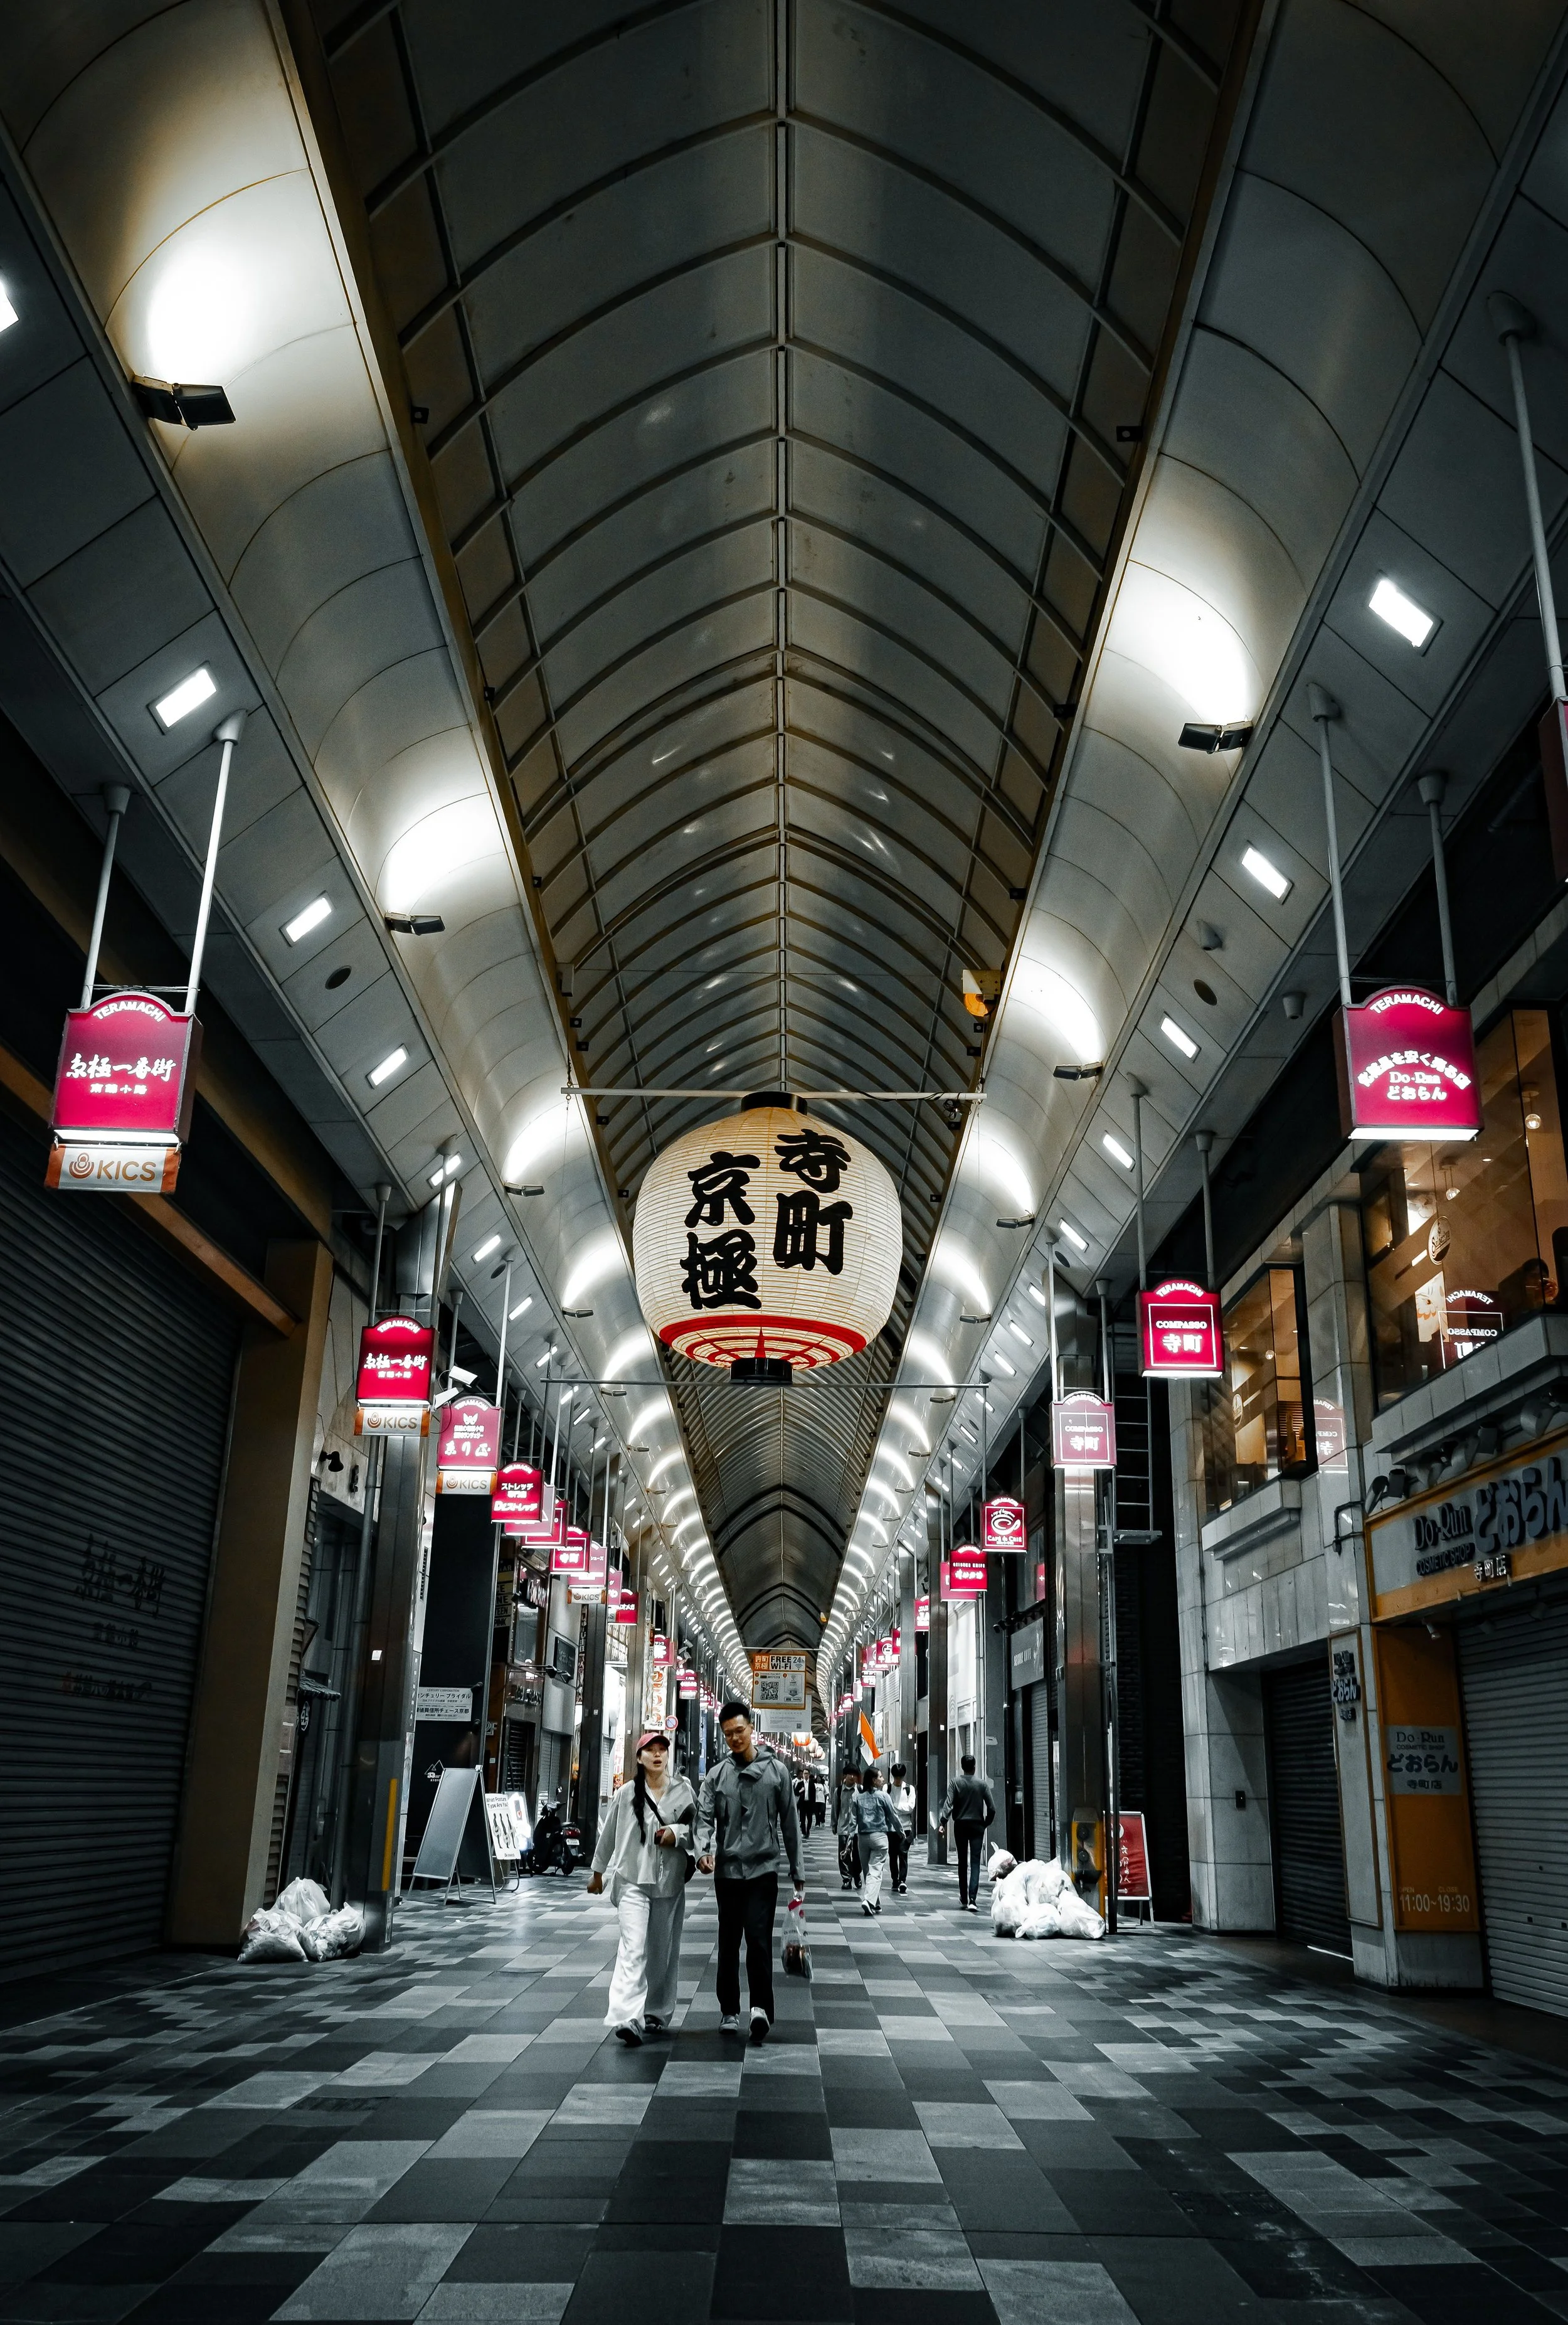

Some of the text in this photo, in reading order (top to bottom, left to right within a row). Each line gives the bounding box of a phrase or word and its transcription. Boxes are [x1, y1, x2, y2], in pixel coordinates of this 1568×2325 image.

[93, 1001, 167, 1023] TERAMACHI
[1370, 994, 1444, 1015] TERAMACHI
[1387, 1085, 1448, 1100] どおらん
[97, 1160, 156, 1181] KICS
[773, 1129, 854, 1275] 寺町
[680, 1151, 762, 1311] 京極
[1155, 1283, 1204, 1297] TERAMACHI
[377, 1320, 421, 1334] TERAMACHI
[1155, 1321, 1208, 1329] COMPASSO
[1162, 1333, 1203, 1353] 寺町
[383, 1416, 418, 1429] KICS
[459, 1479, 487, 1489] KICS
[1474, 1457, 1568, 1553] どおらん
[1416, 1542, 1475, 1576] COSMETIC SHOP
[793, 1656, 805, 1664] 24h
[1396, 1732, 1445, 1743] Do-Run
[1387, 1753, 1458, 1773] どおらん
[1407, 1779, 1442, 1790] 寺町店
[1438, 1885, 1459, 1893] CLOSE
